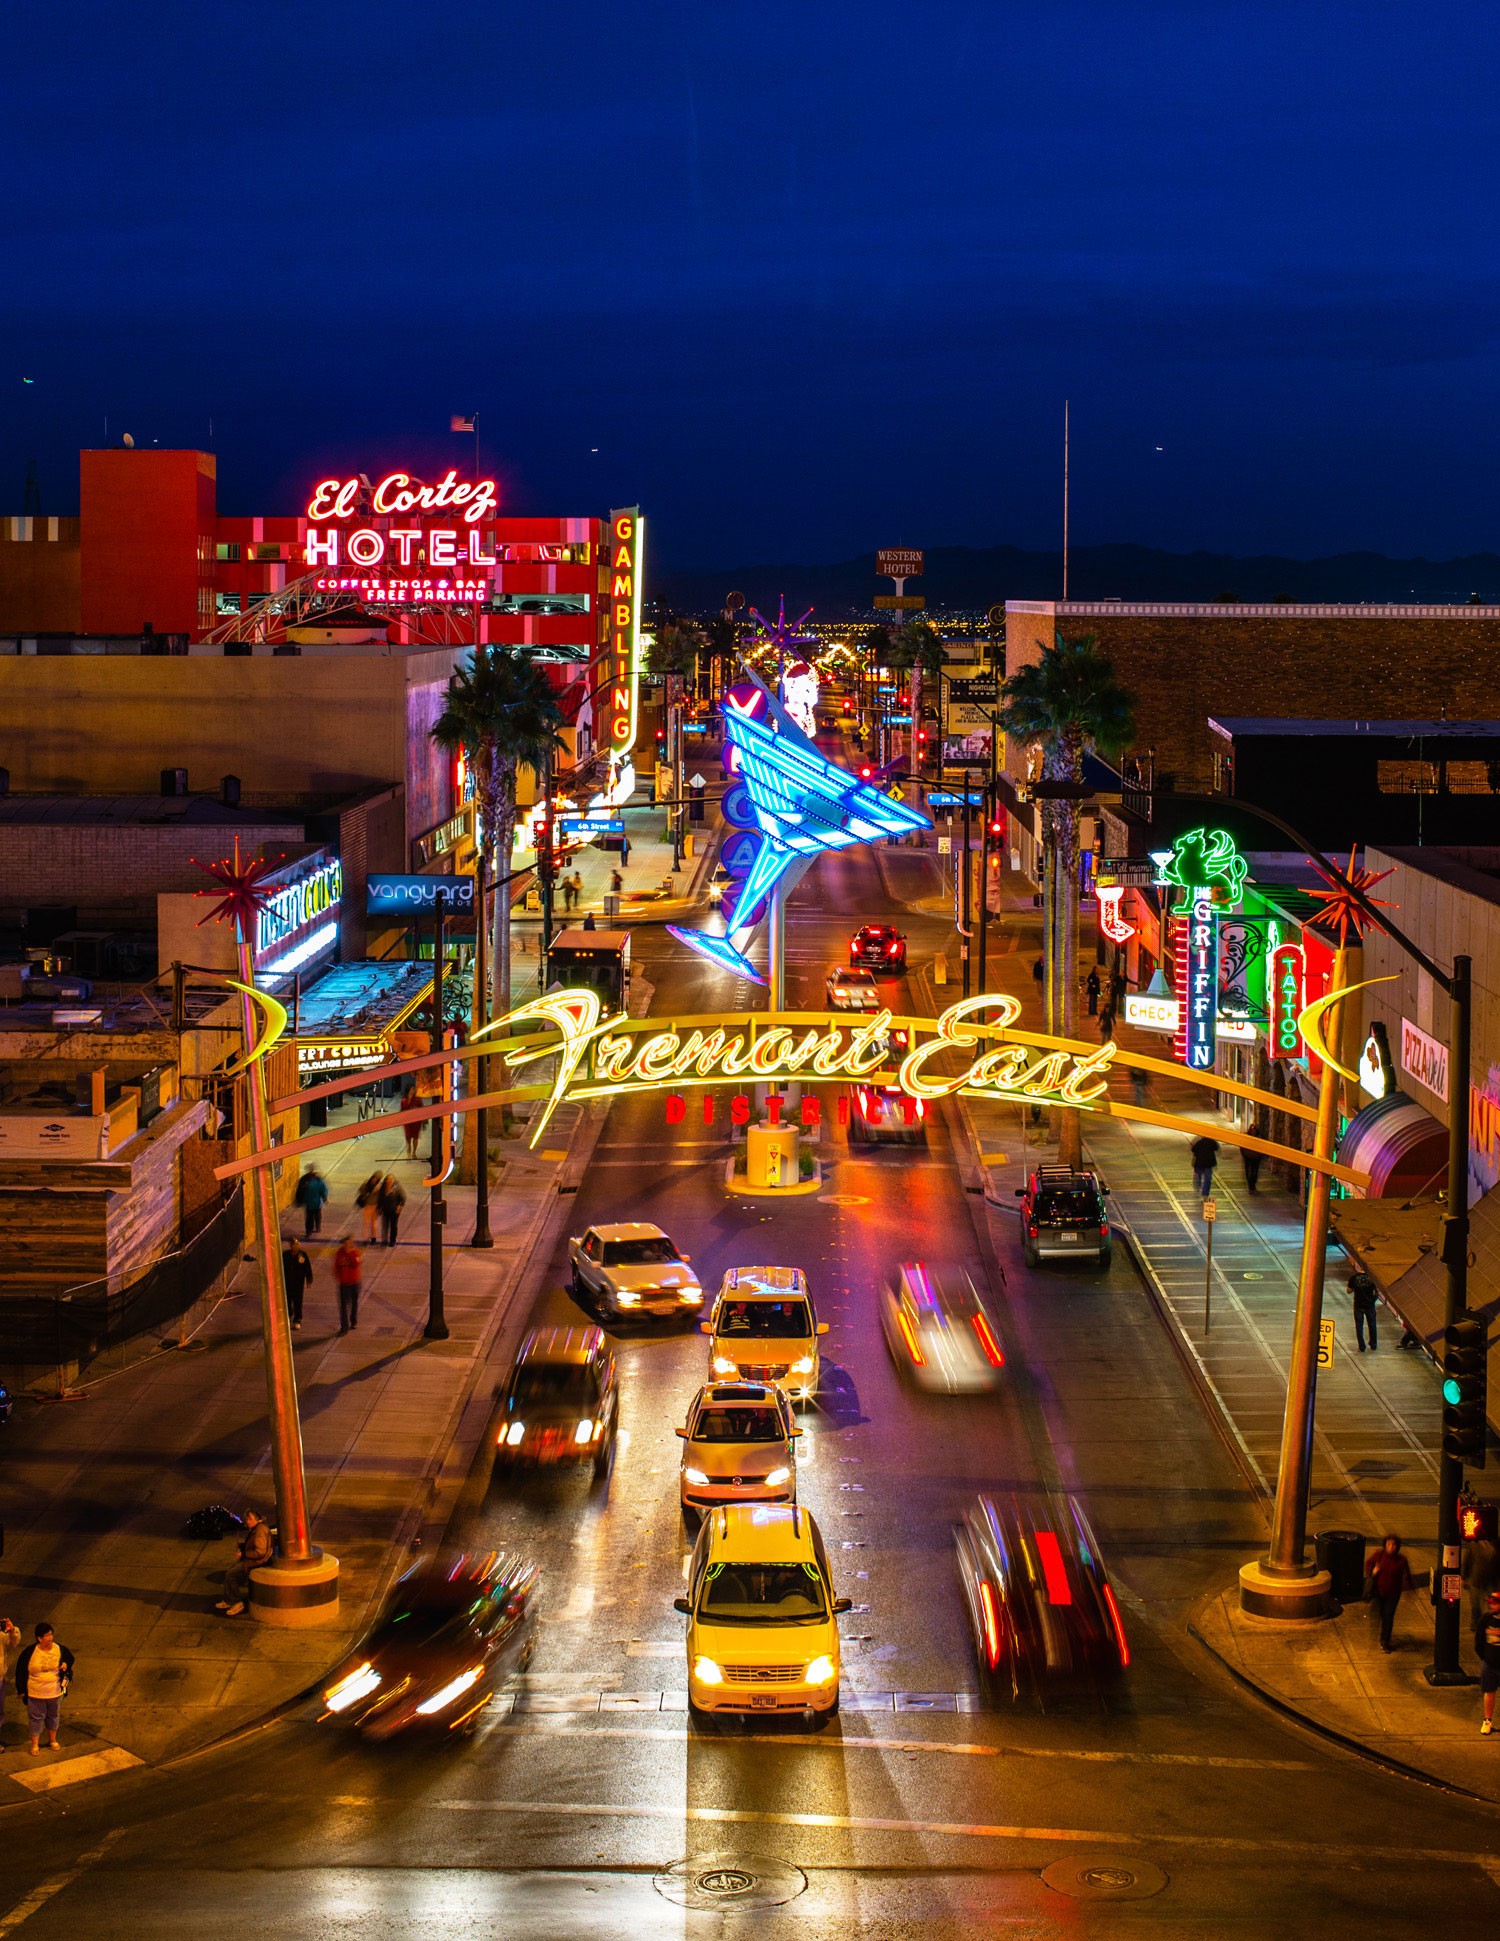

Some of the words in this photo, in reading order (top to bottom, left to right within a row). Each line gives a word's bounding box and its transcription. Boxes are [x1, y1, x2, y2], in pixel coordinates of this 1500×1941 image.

[308, 479, 359, 520] El
[373, 470, 497, 522] Cortez
[306, 528, 497, 566] HOTEL
[878, 551, 923, 561] WESTERN
[317, 579, 381, 589] COFFEE
[389, 579, 431, 589] SHOP
[438, 579, 449, 589] &
[455, 579, 487, 589] BAR
[883, 563, 918, 574] HOTEL
[367, 589, 406, 601] FREE
[414, 589, 486, 601] PARKING
[613, 517, 633, 739] GAMBLING
[590, 822, 610, 830] Street
[367, 880, 474, 905] vanguard
[1193, 900, 1213, 1066] GRIFFIN
[1280, 957, 1298, 1050] TATTOO
[470, 988, 893, 1150] Fremont
[899, 993, 1117, 1103] East
[1403, 1027, 1428, 1084] PIZZA
[1427, 1046, 1447, 1096] Deli
[665, 1094, 926, 1125] DISTRICT
